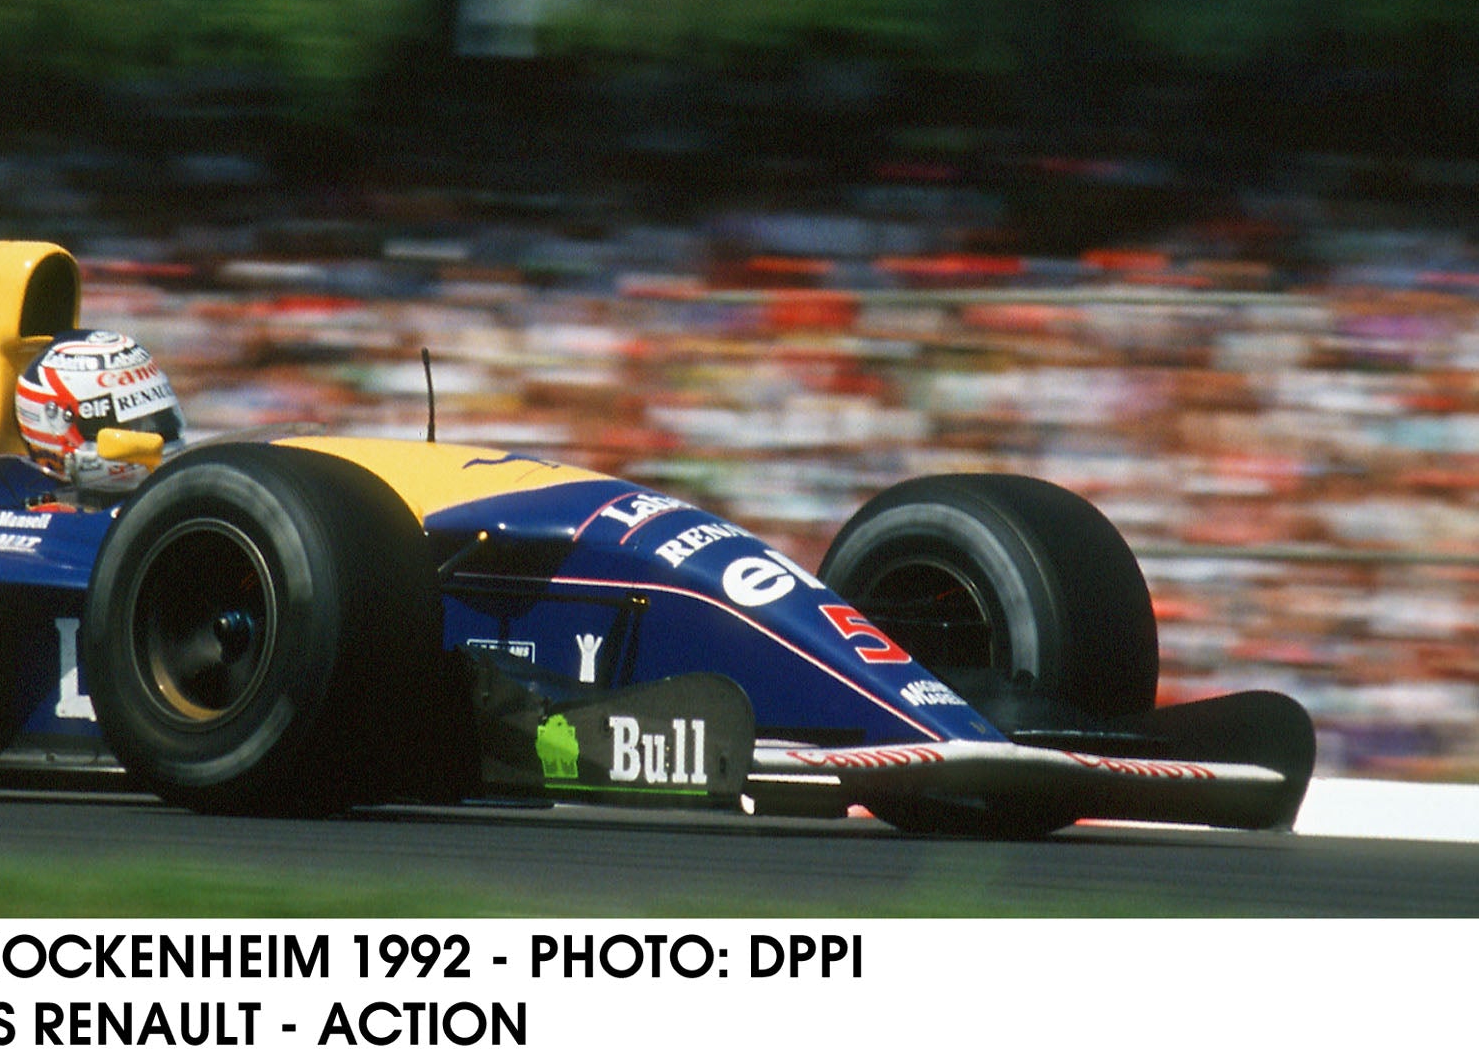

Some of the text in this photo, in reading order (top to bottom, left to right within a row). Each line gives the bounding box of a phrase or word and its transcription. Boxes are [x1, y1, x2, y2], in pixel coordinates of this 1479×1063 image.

[78, 398, 112, 419] elf
[654, 522, 757, 569] RENA
[722, 548, 827, 608] el
[819, 604, 913, 664] 5
[608, 715, 709, 785] Bull
